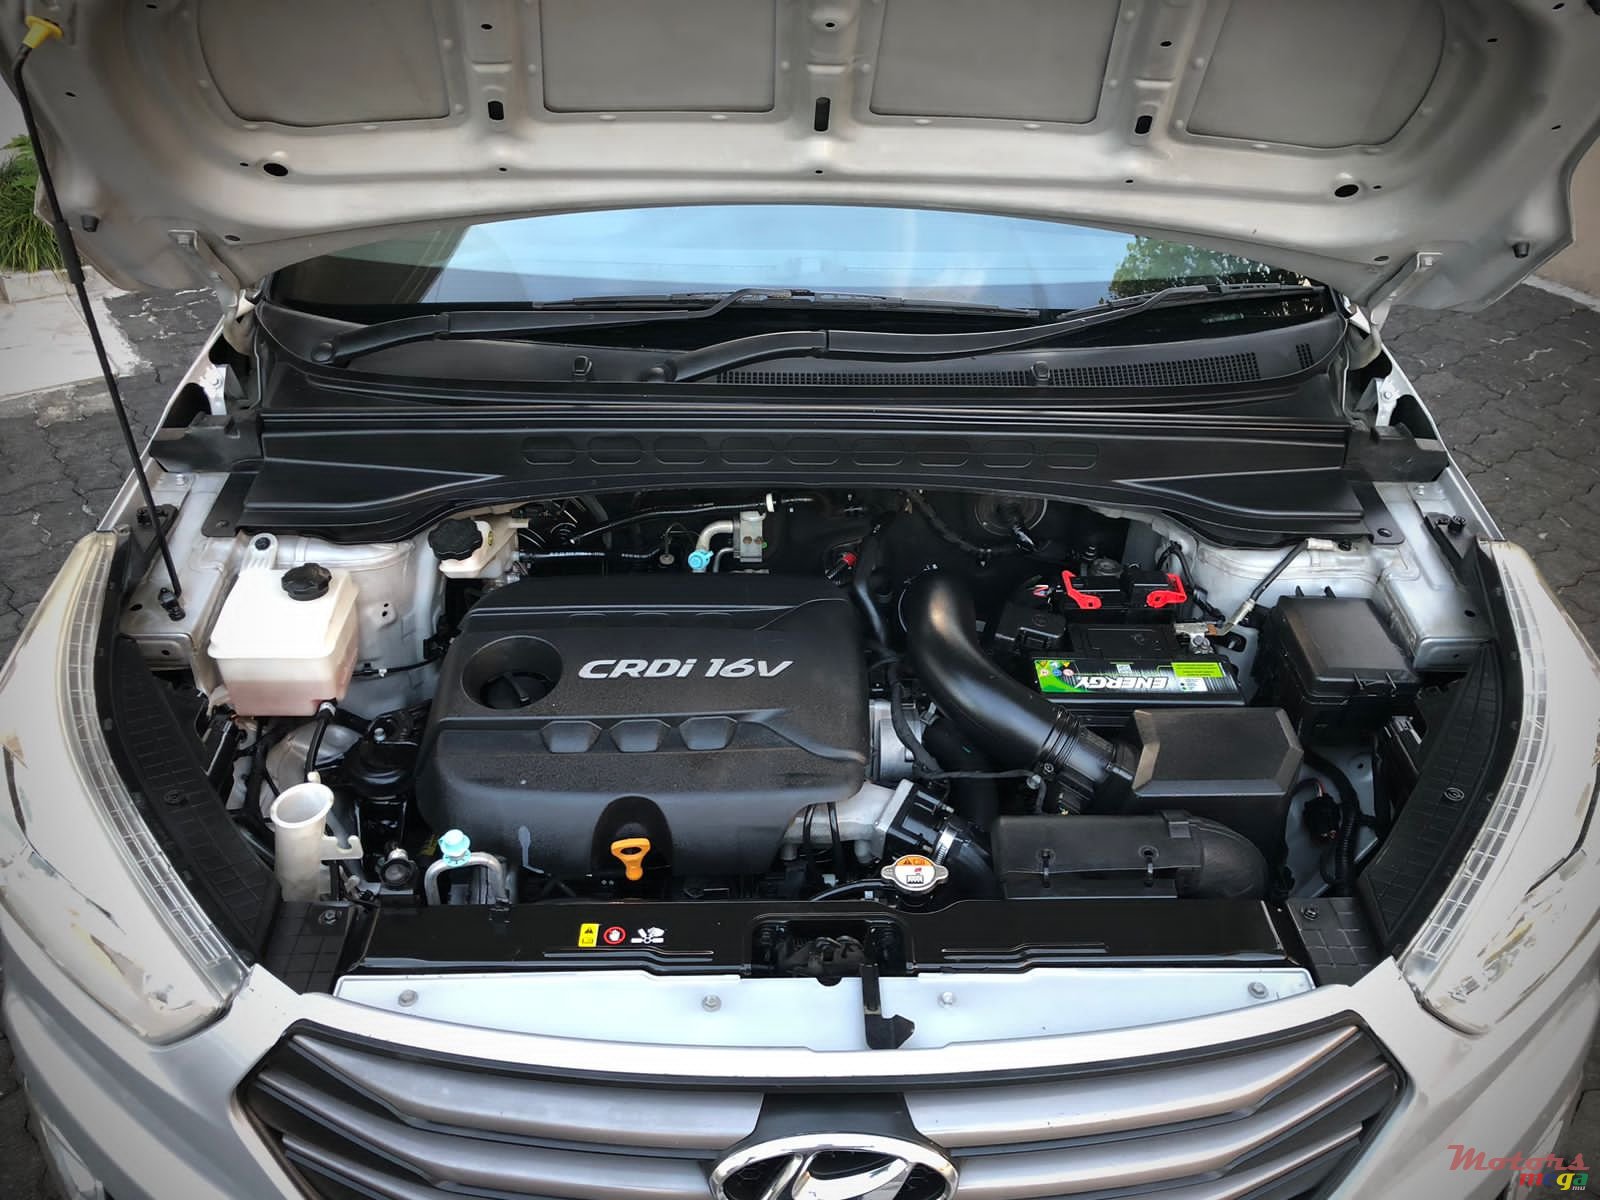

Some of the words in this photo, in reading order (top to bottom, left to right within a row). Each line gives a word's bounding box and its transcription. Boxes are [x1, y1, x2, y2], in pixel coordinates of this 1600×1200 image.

[578, 658, 697, 679] CRDi
[704, 658, 793, 678] 16V
[1076, 676, 1169, 689] ENERGY
